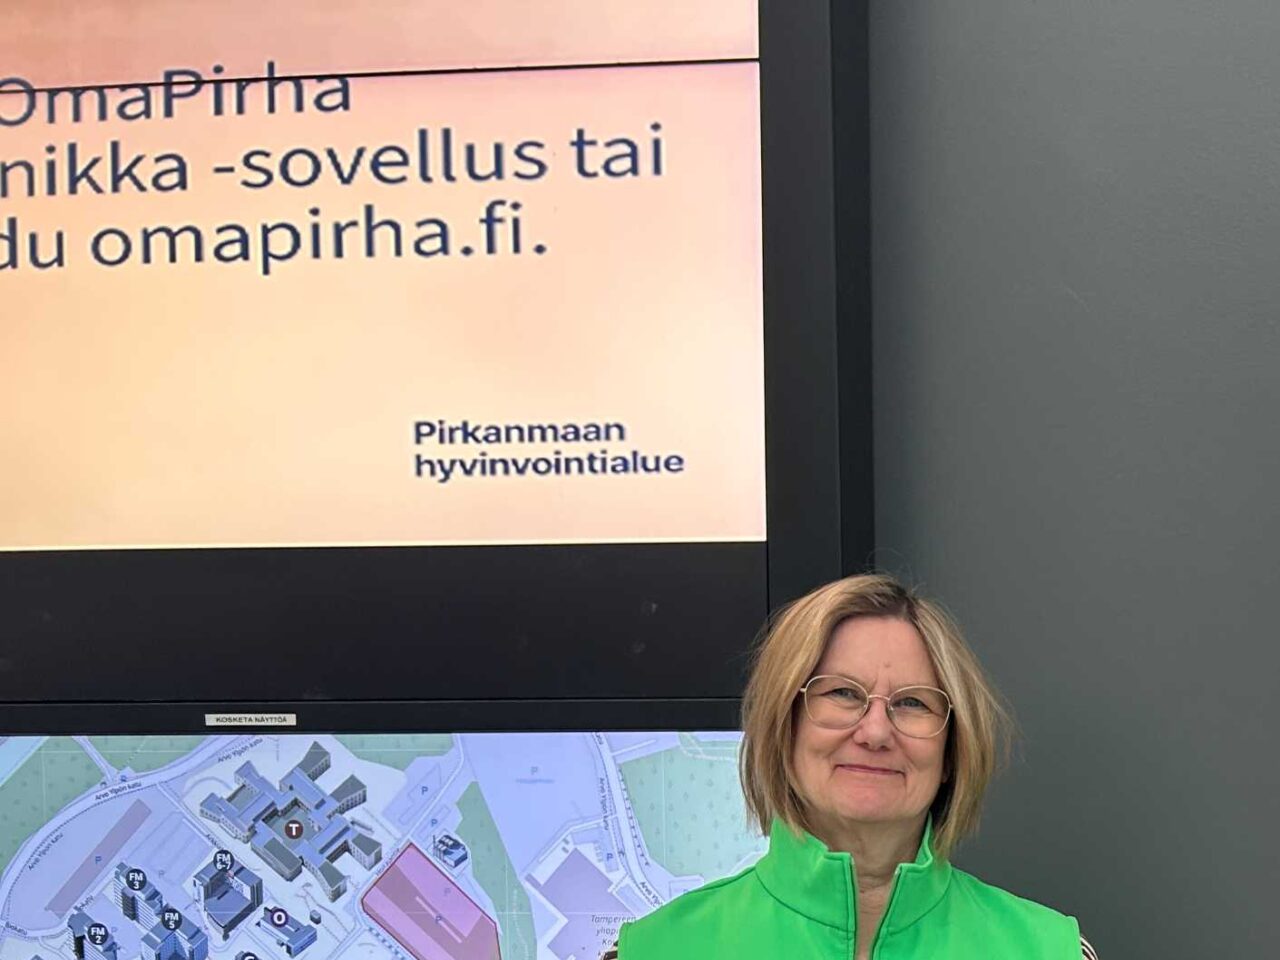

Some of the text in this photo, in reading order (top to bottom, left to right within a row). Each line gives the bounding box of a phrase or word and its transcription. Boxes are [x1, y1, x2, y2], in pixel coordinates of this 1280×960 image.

[0, 61, 352, 127] OmaPirha
[213, 128, 549, 189] -sovellus
[571, 122, 665, 178] tai
[91, 199, 549, 275] omapirha.fi.
[414, 420, 626, 446] Pirkanmaan
[415, 450, 686, 484] hyvinvointialue
[215, 714, 288, 724] KOSKETA NÄYTTÖÄ
[289, 823, 299, 836] T
[216, 853, 231, 862] FM
[216, 861, 231, 870] 6-7
[129, 872, 144, 881] FM
[133, 881, 140, 890] 3
[164, 912, 179, 921] FM
[273, 912, 286, 924] O
[168, 921, 175, 929] 5
[90, 927, 106, 936] FM
[95, 935, 102, 944] 2
